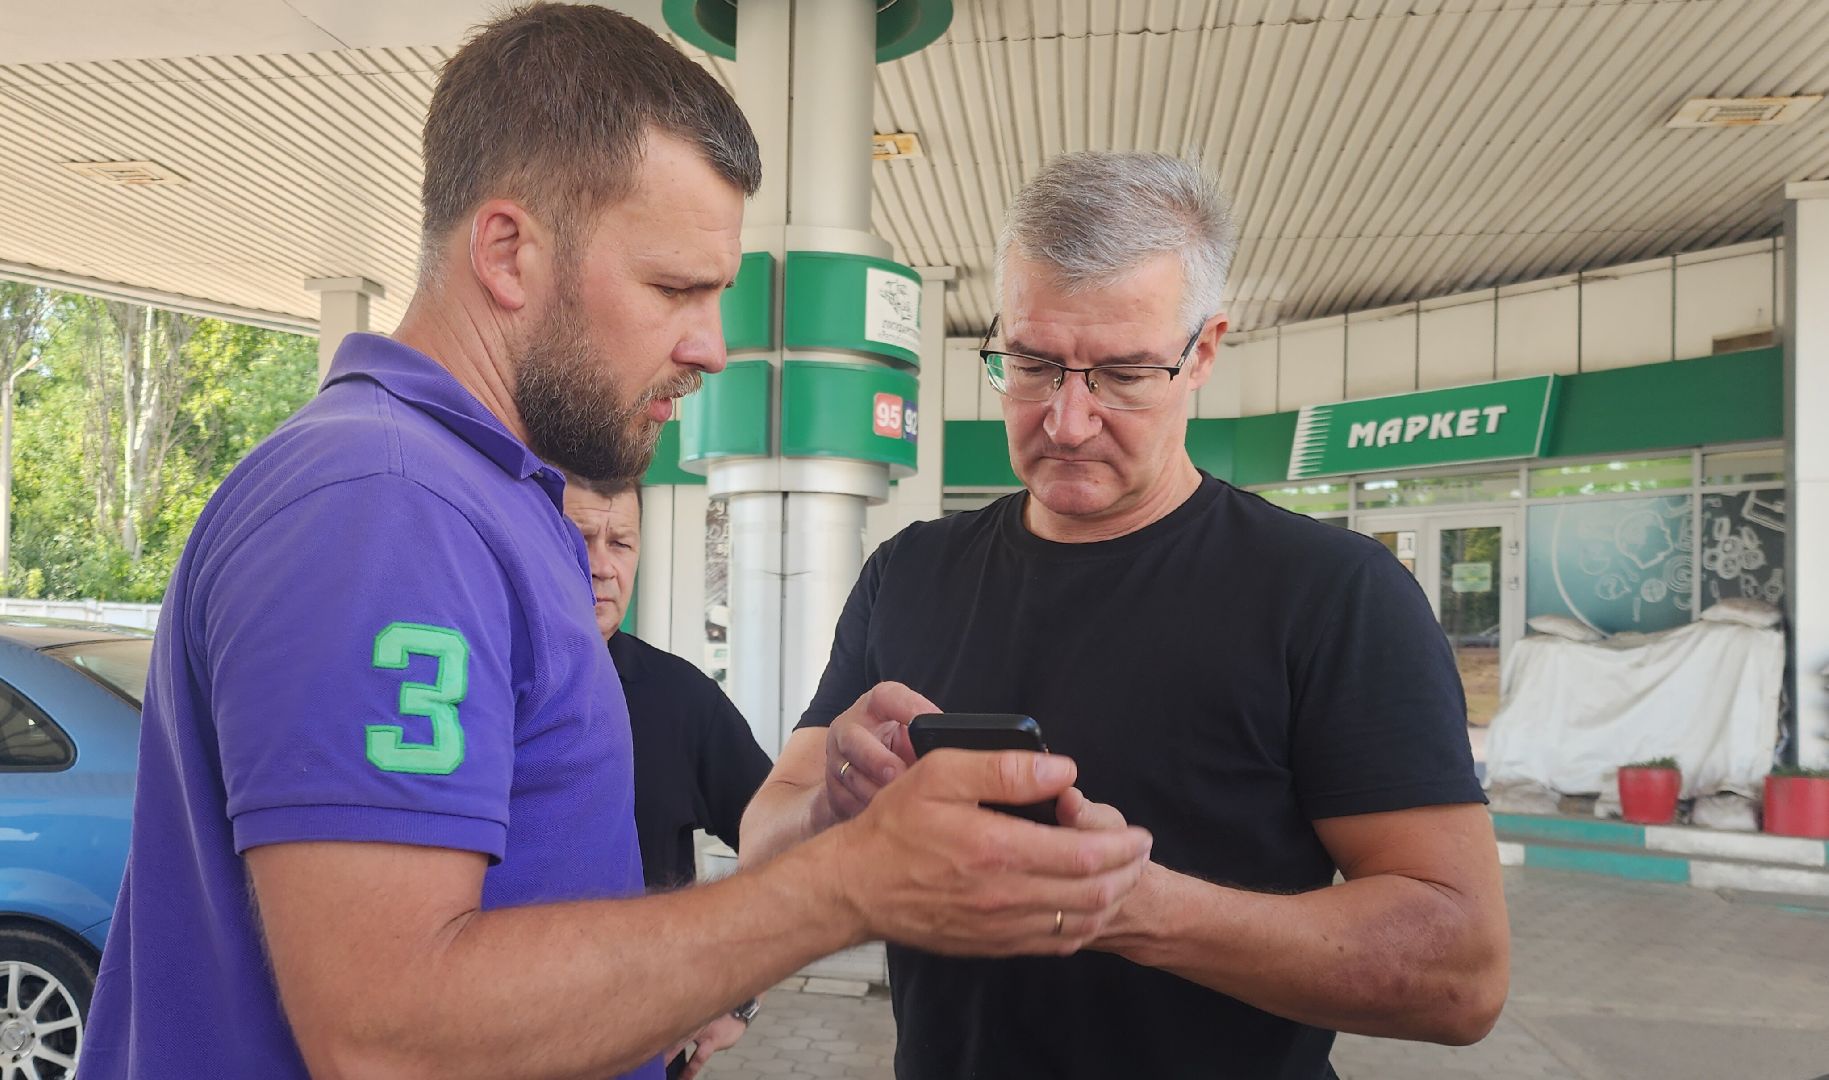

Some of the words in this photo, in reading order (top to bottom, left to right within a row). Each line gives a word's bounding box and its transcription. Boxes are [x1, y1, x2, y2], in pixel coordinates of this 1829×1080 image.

[876, 402, 901, 429] 95
[1347, 405, 1508, 448] МАРКЕТ
[365, 621, 470, 775] 3
